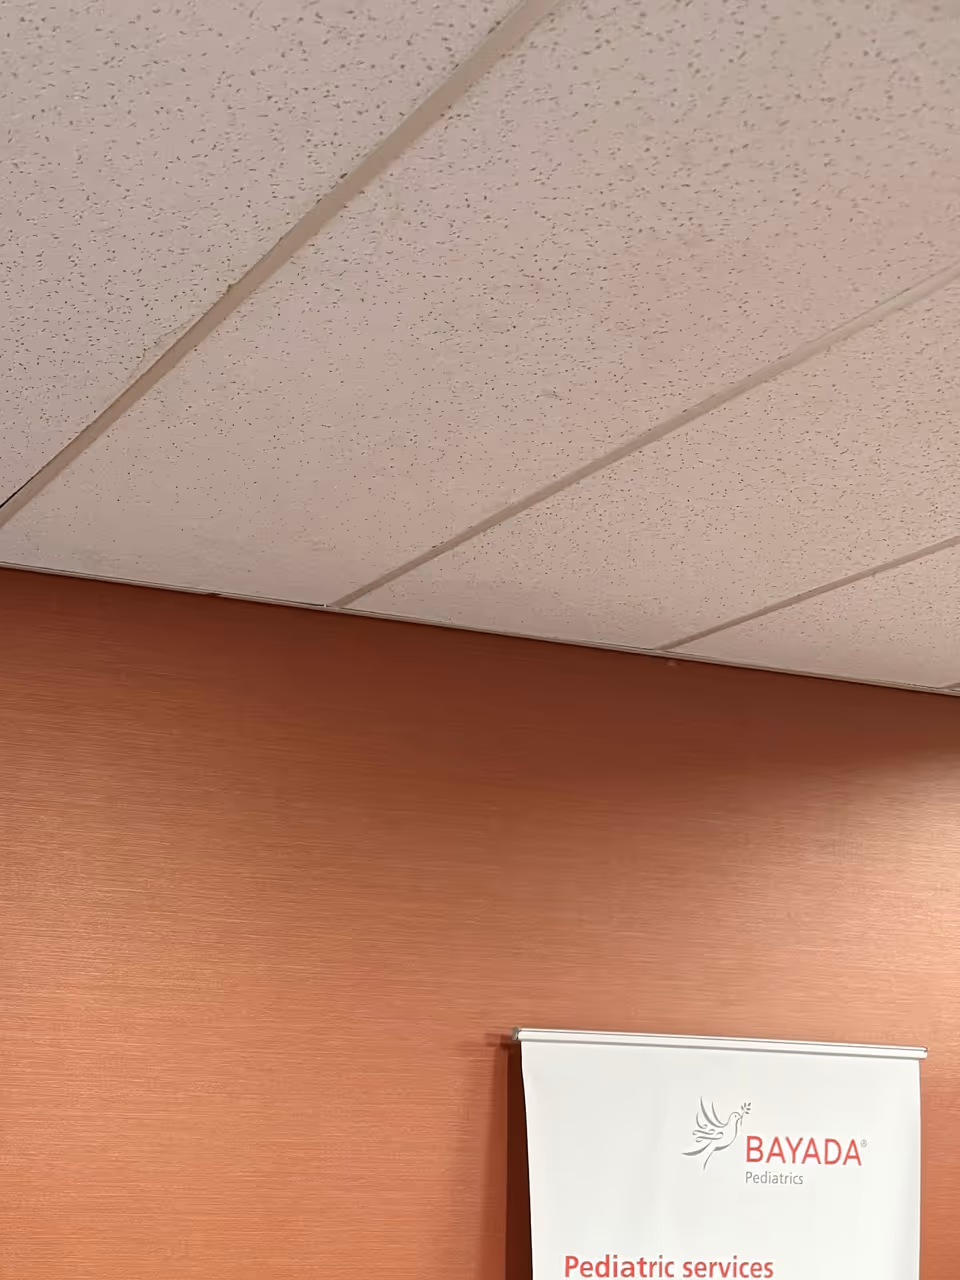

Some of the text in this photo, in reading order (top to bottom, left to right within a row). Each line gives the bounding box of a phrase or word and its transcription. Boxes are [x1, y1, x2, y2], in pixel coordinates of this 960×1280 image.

[746, 1171, 803, 1184] Pediatrics
[565, 1254, 773, 1278] Pediatric services
